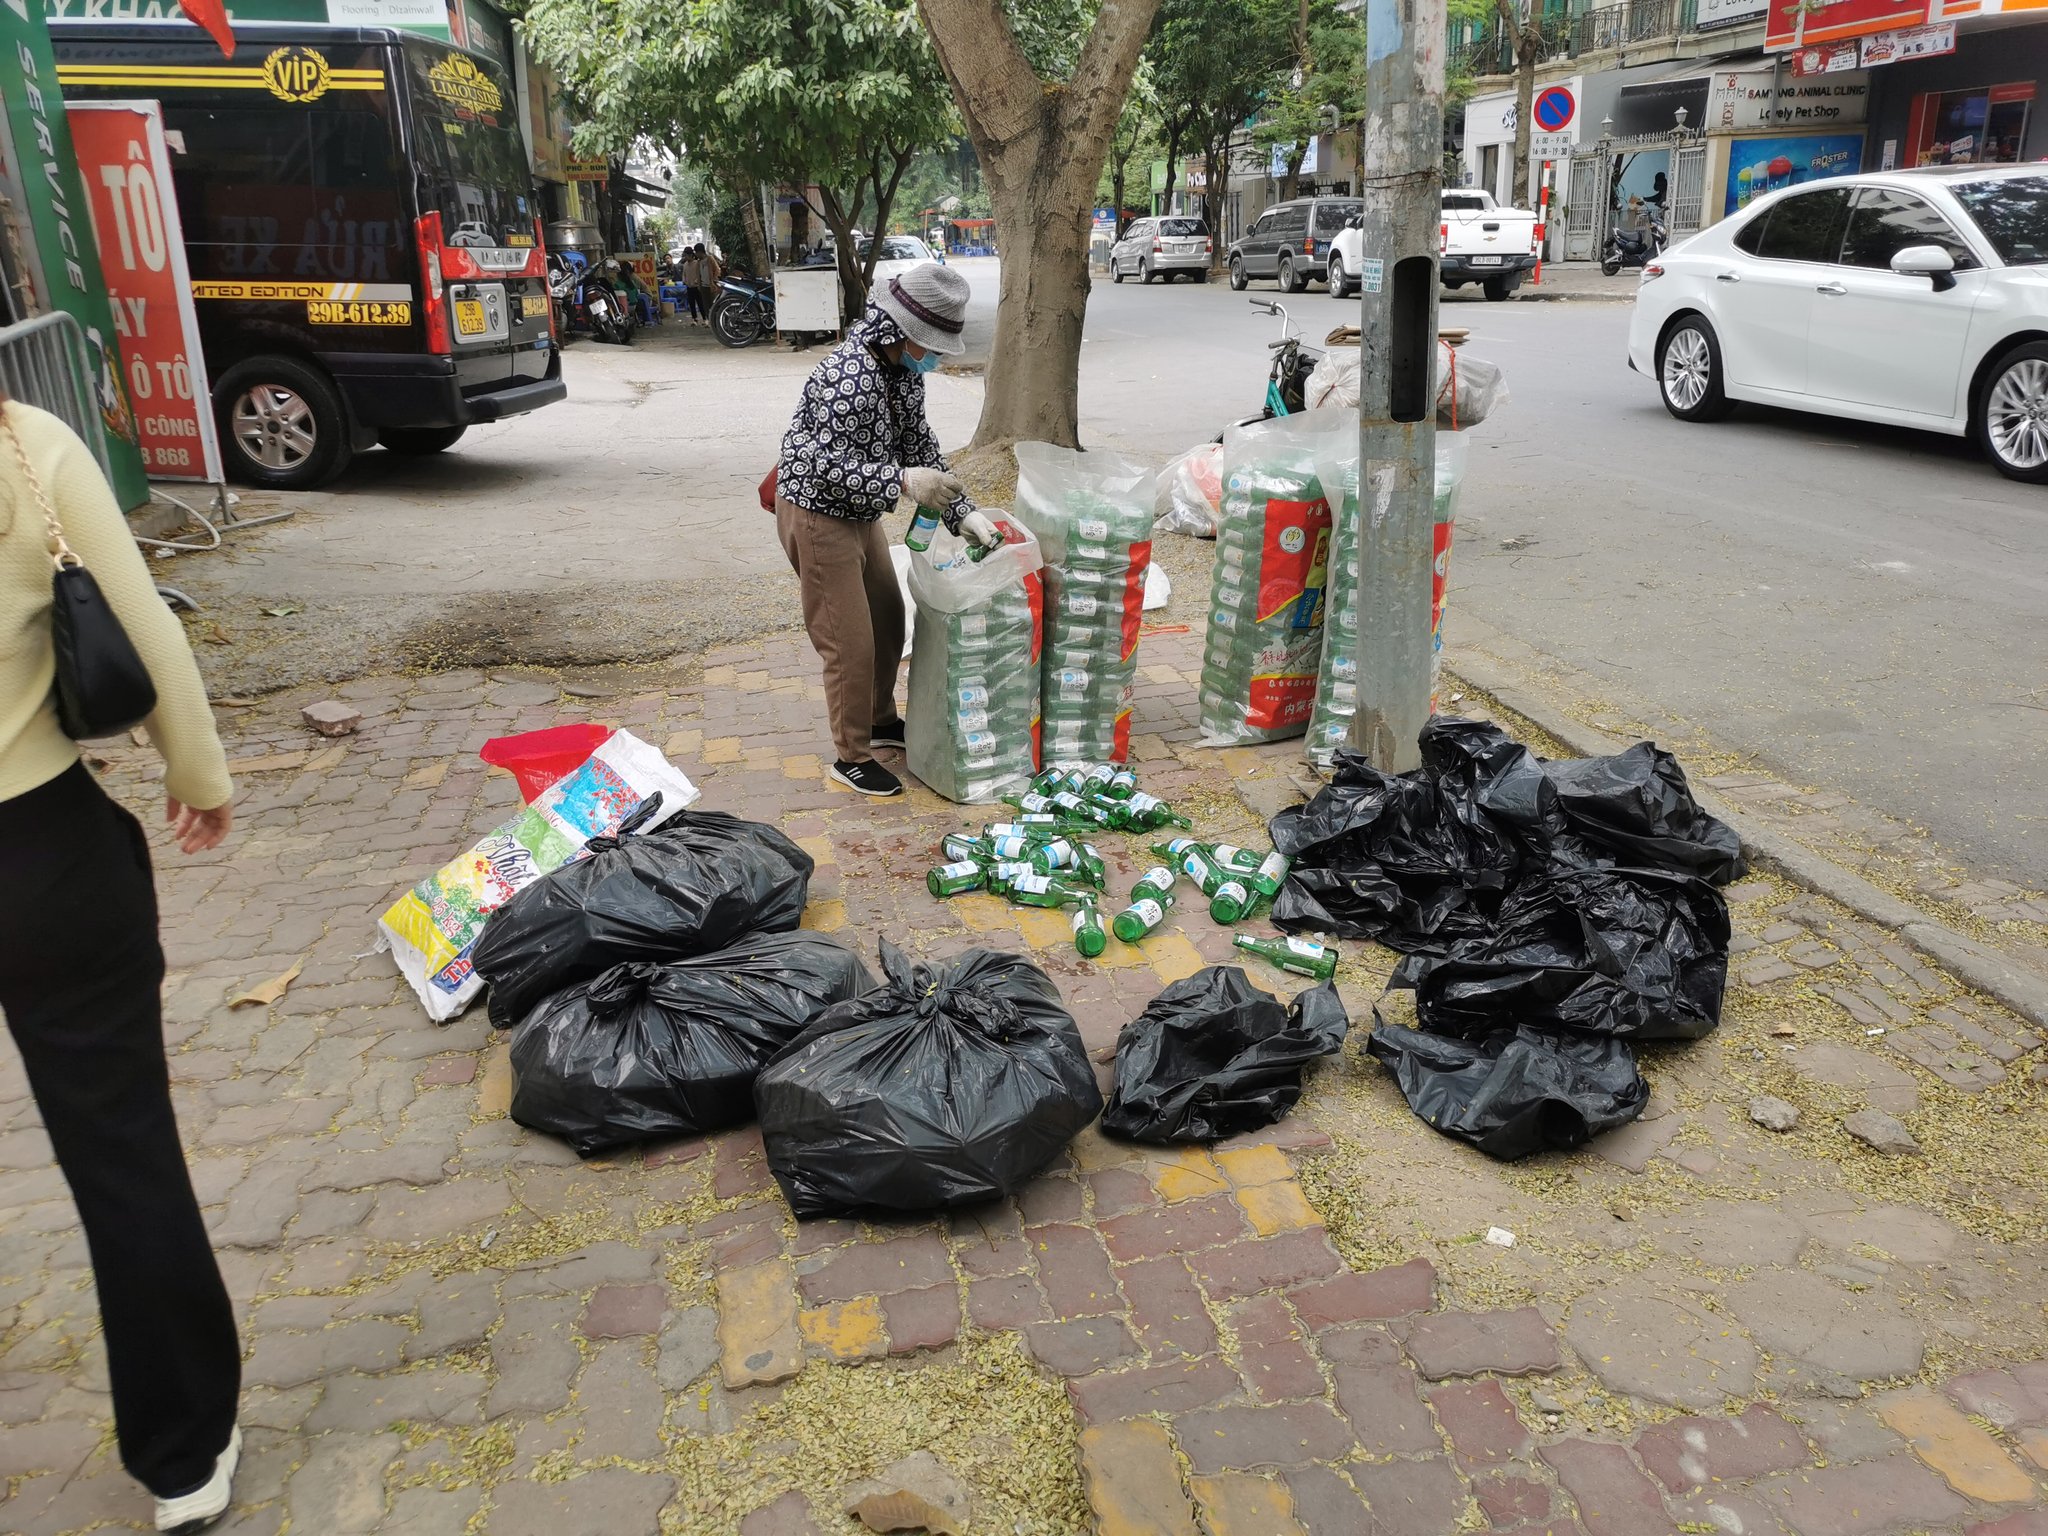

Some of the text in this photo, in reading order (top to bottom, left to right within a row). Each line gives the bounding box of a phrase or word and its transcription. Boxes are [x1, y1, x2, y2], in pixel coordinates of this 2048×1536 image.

[342, 4, 435, 16] Flooring Dizainwall
[277, 55, 317, 91] VIP
[431, 79, 502, 107] LIMOUSINE
[1796, 86, 1831, 97] ANIMAL
[1834, 85, 1866, 96] CLINIC
[1759, 105, 1840, 122] Loely Pet Shop
[17, 39, 87, 294] SERVICE
[1811, 152, 1848, 168] FROSTER
[100, 140, 166, 272] TÔ
[251, 286, 324, 298] EDITION
[108, 288, 147, 337] ÁY
[308, 302, 411, 325] 29B-612.39
[131, 353, 194, 400] Ô TÔ
[145, 414, 198, 437] CÔNG
[156, 447, 190, 466] 868
[431, 896, 464, 938] 25 kg
